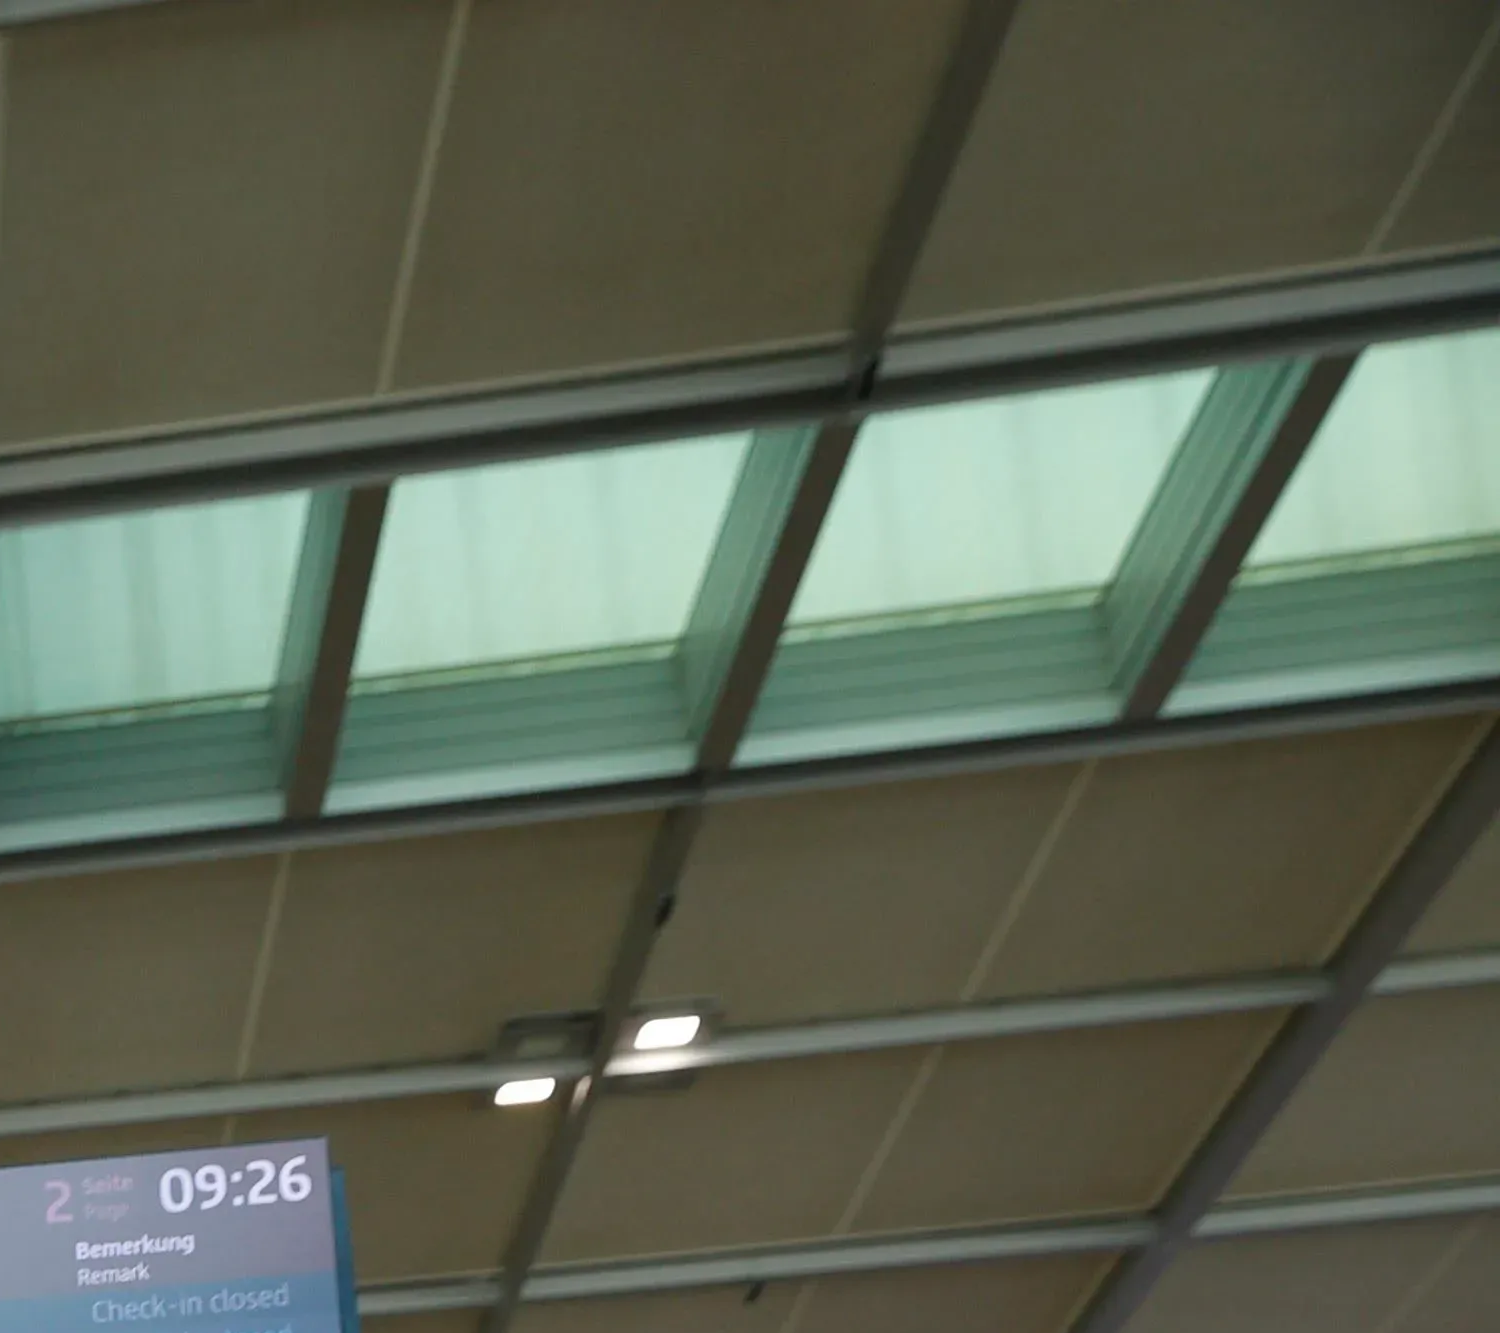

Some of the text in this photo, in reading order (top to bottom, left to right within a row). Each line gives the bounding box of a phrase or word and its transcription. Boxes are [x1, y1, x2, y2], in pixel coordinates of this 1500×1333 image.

[159, 1154, 313, 1213] 09:26
[75, 1233, 196, 1261] Bemerkung
[77, 1260, 151, 1287] Remark
